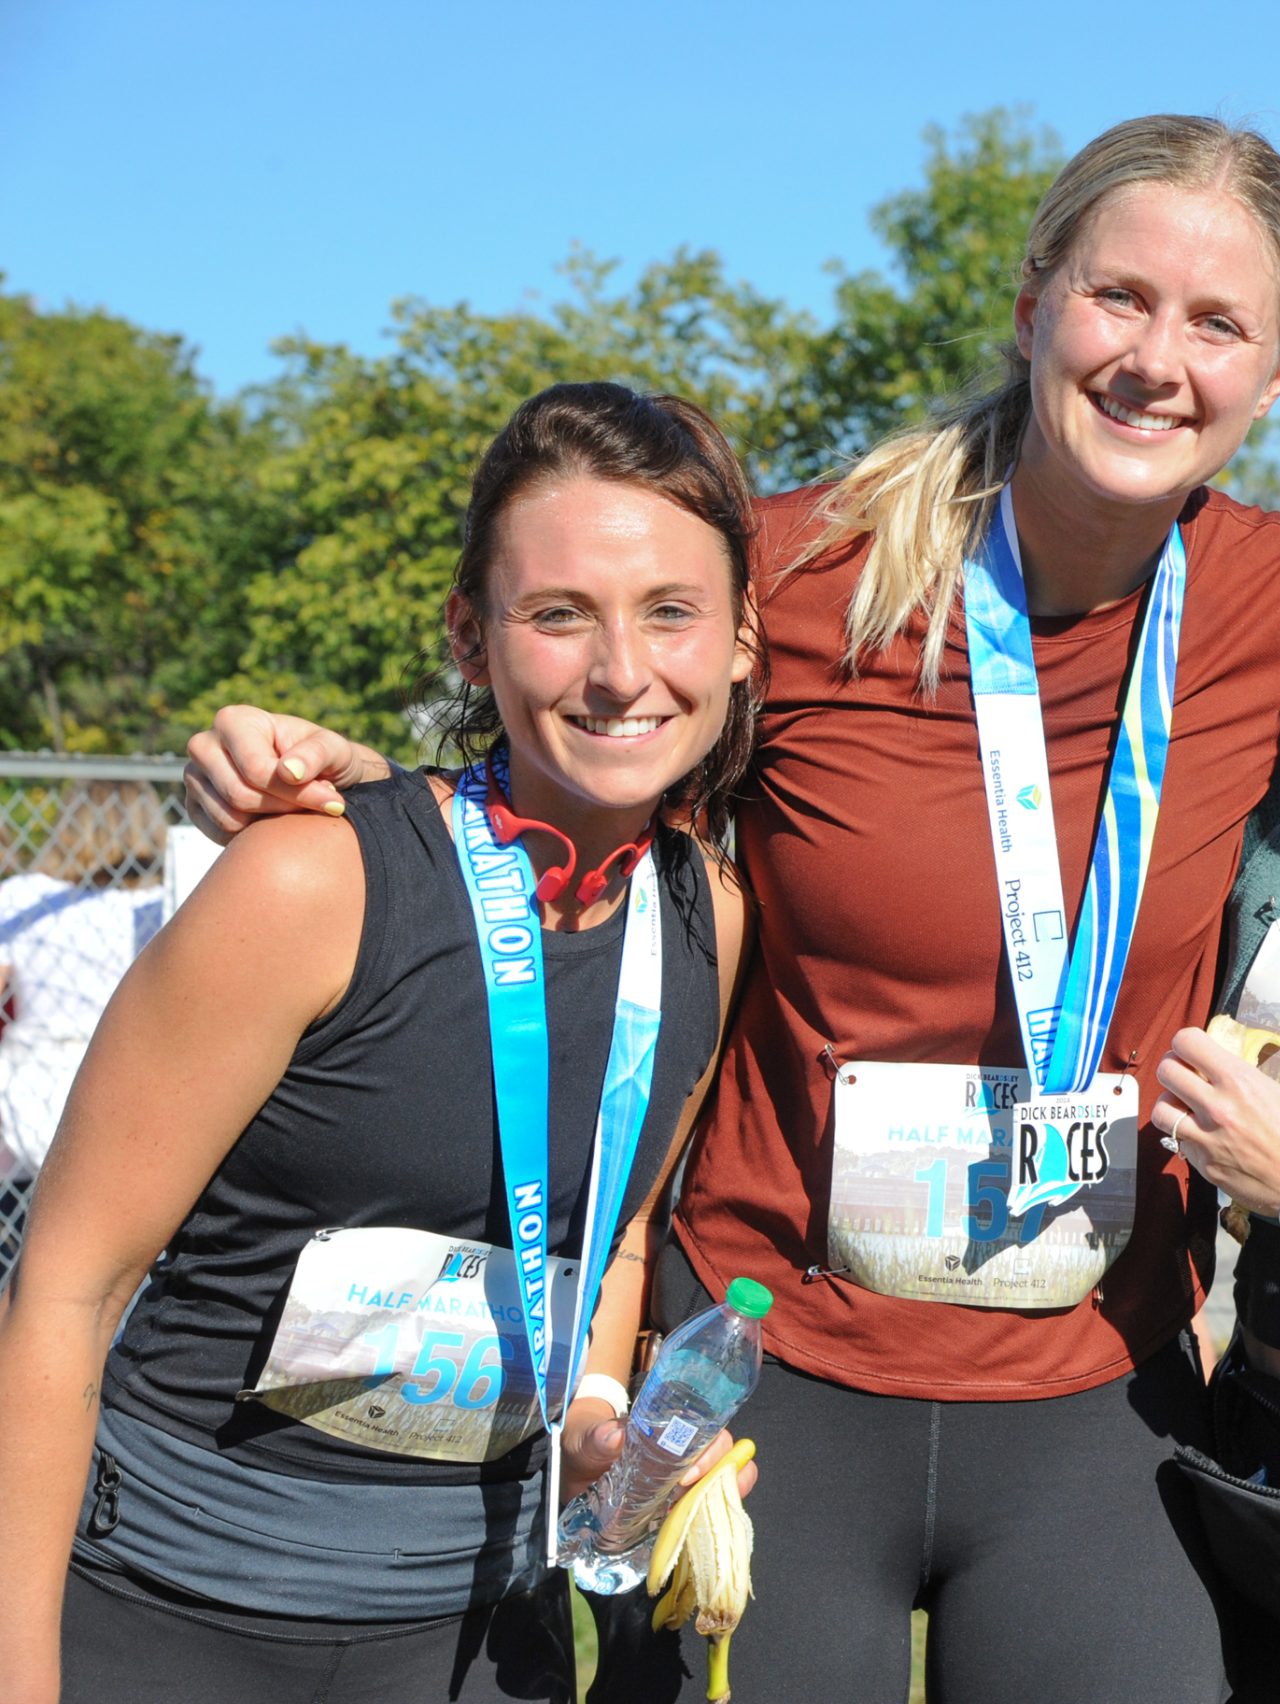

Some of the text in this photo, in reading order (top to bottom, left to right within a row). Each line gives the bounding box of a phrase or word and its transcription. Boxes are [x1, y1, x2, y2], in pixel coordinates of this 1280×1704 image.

[990, 750, 1012, 853] Essentia Health
[1005, 878, 1033, 982] Project 412
[1021, 1104, 1109, 1120] DICK BEARDSLEY
[888, 1125, 948, 1146] HALF
[918, 1275, 1046, 1289] Essentia Health Project 412
[347, 1284, 523, 1324] HALF MARATHO
[363, 1323, 514, 1411] 156
[334, 1410, 370, 1430] Essentia
[371, 1424, 399, 1437] Health
[408, 1431, 446, 1444] Project
[446, 1434, 463, 1445] 412
